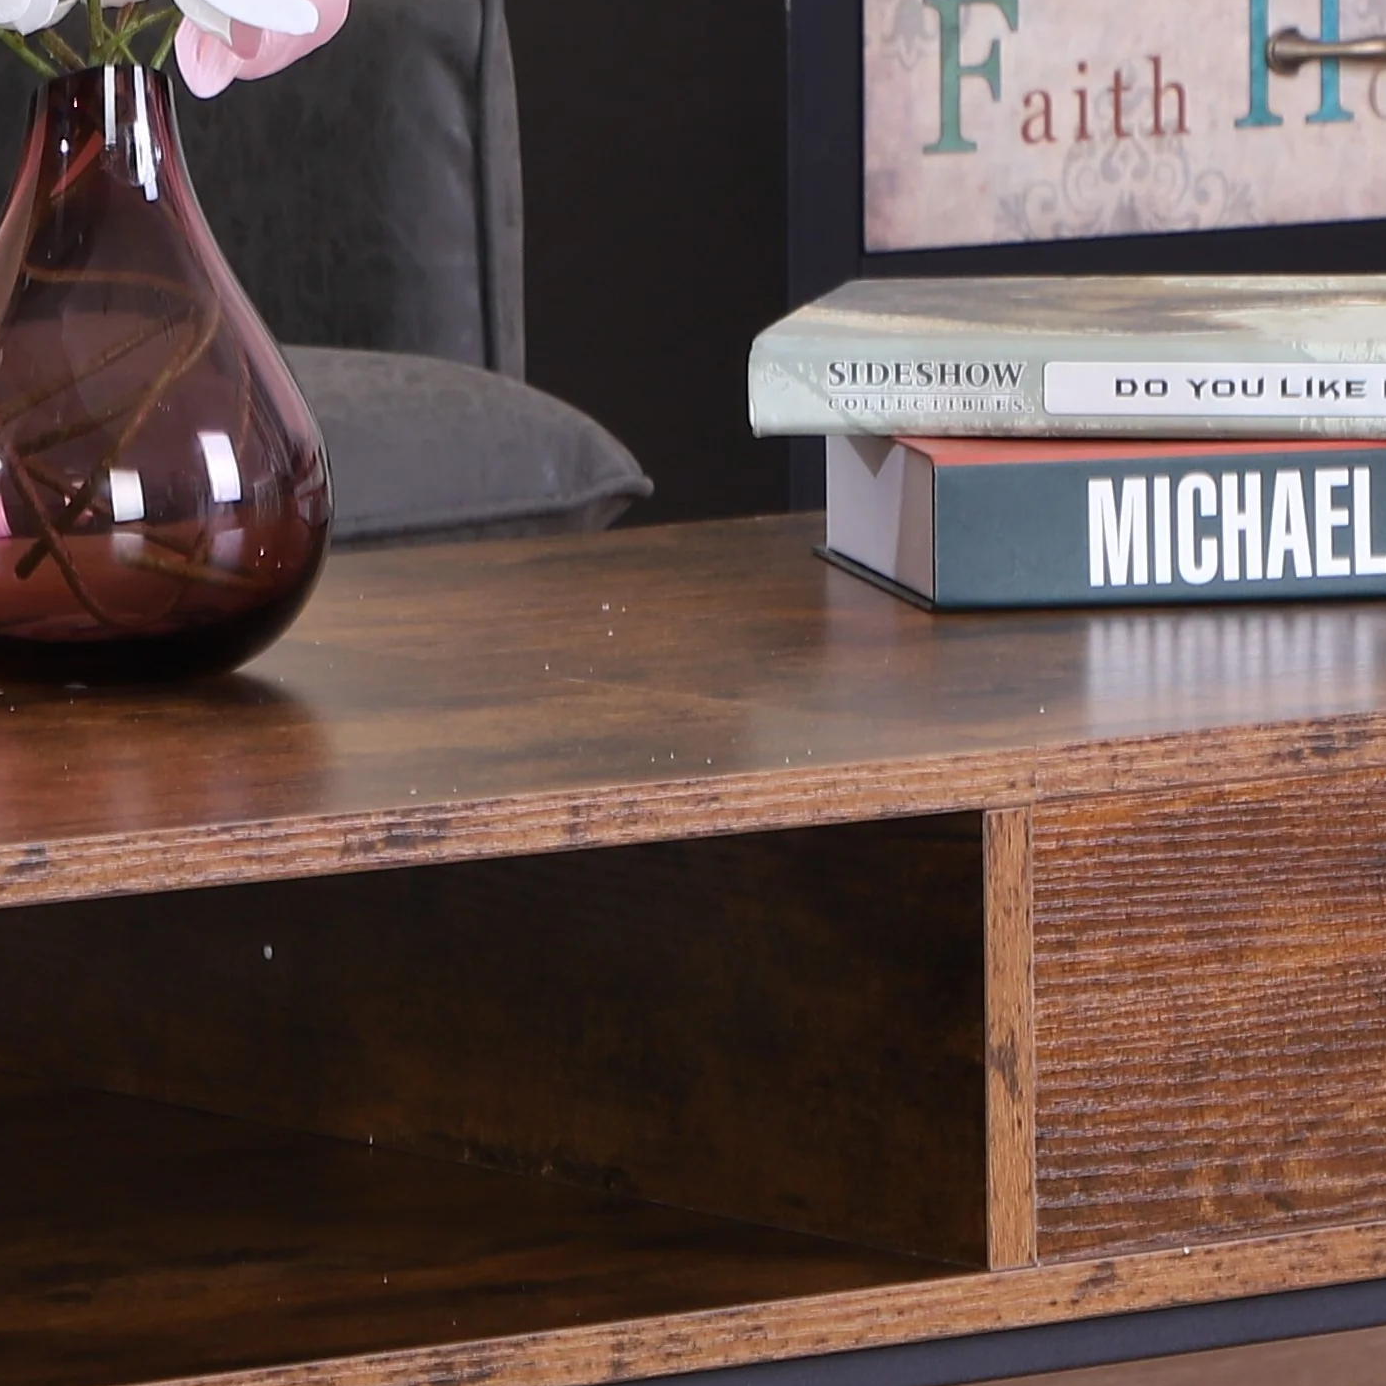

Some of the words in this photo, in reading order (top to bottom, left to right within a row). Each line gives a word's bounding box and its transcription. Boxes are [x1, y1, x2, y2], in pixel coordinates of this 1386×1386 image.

[828, 361, 1027, 388] SIDESHOW
[1115, 377, 1168, 398] DO
[1186, 376, 1264, 401] YOU
[1280, 376, 1367, 402] LIKE
[828, 395, 1024, 412] COLLECTIBLES
